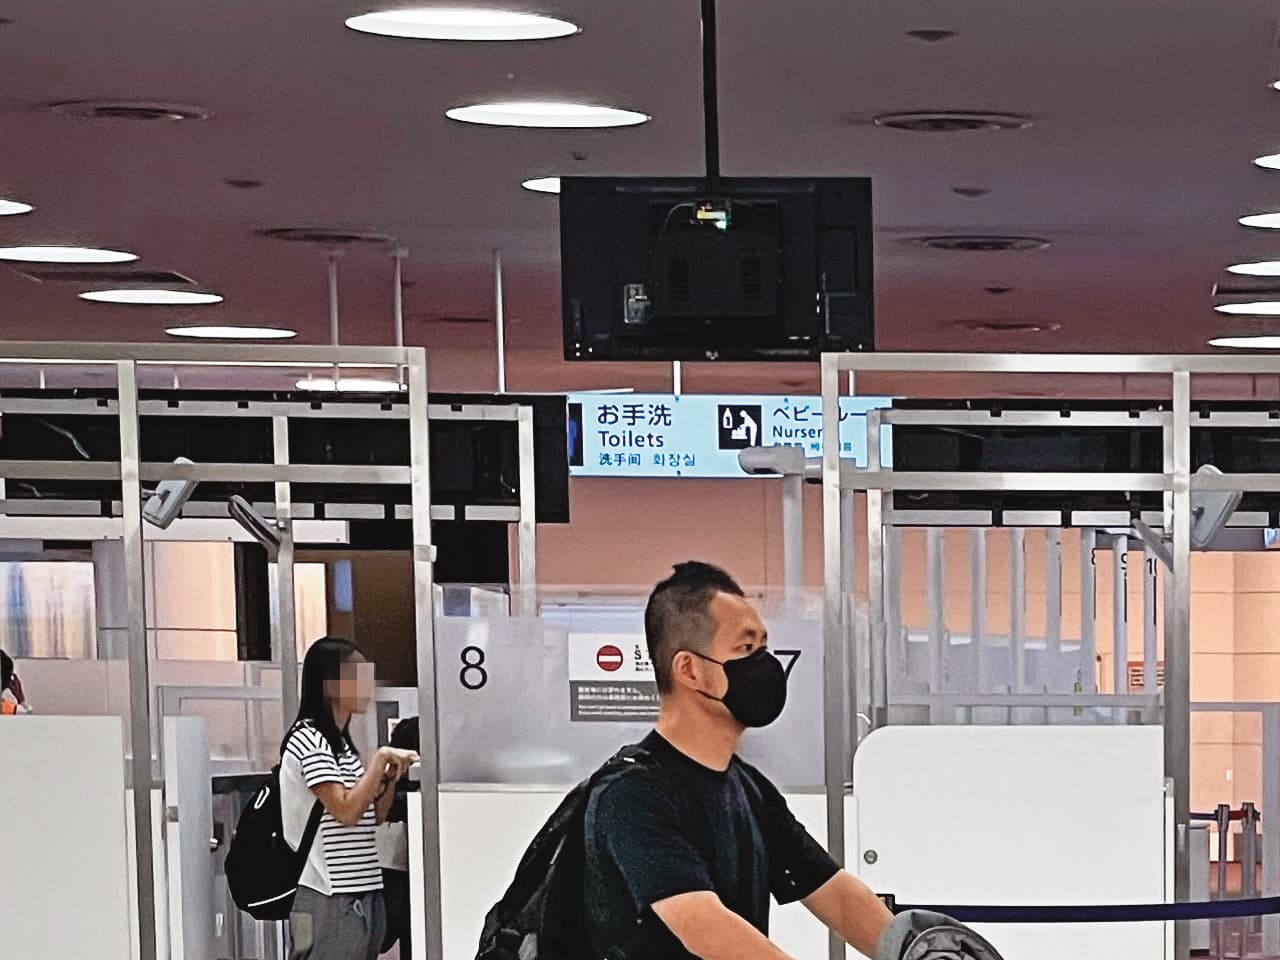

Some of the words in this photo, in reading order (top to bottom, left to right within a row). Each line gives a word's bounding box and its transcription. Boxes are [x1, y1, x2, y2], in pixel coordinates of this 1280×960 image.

[597, 403, 672, 427] お手洗
[597, 429, 664, 448] Toilets
[772, 425, 823, 438] Nurser
[460, 646, 487, 690] 8
[773, 649, 801, 681] 7
